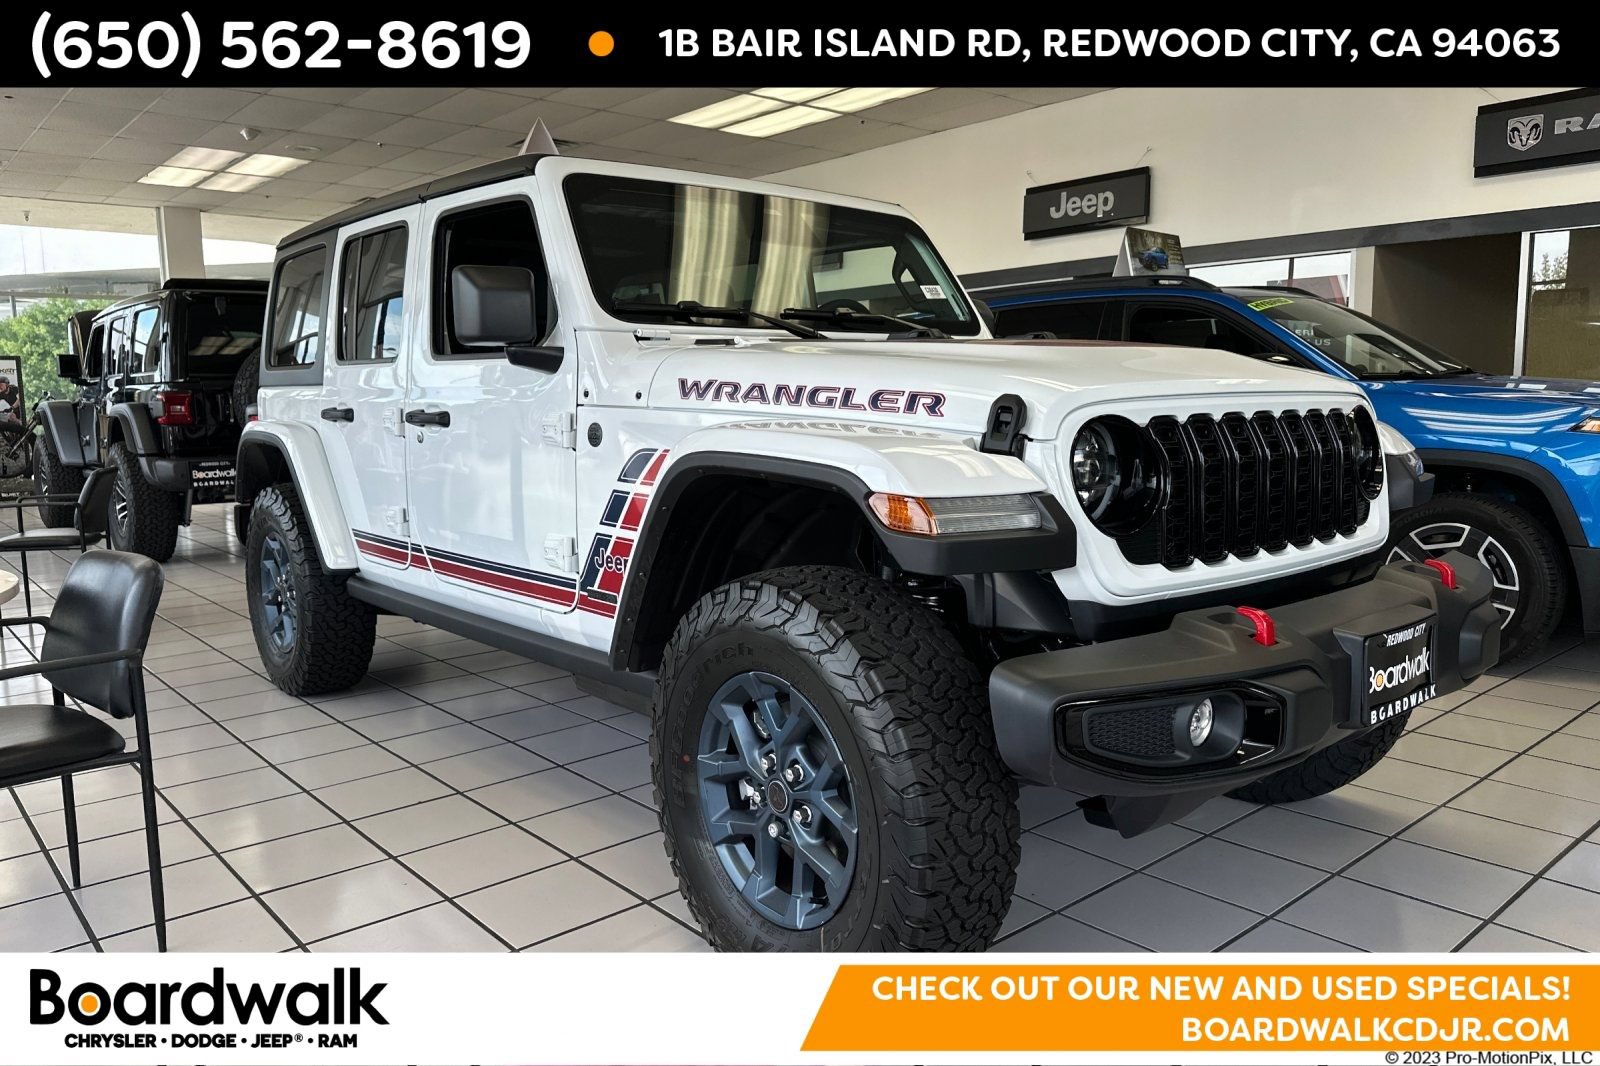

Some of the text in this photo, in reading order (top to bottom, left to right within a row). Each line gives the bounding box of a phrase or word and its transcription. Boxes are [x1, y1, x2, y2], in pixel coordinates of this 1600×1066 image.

[1049, 190, 1115, 219] Jeep
[678, 377, 946, 417] WRANGLER
[1386, 622, 1427, 647] REDWOOD CITY
